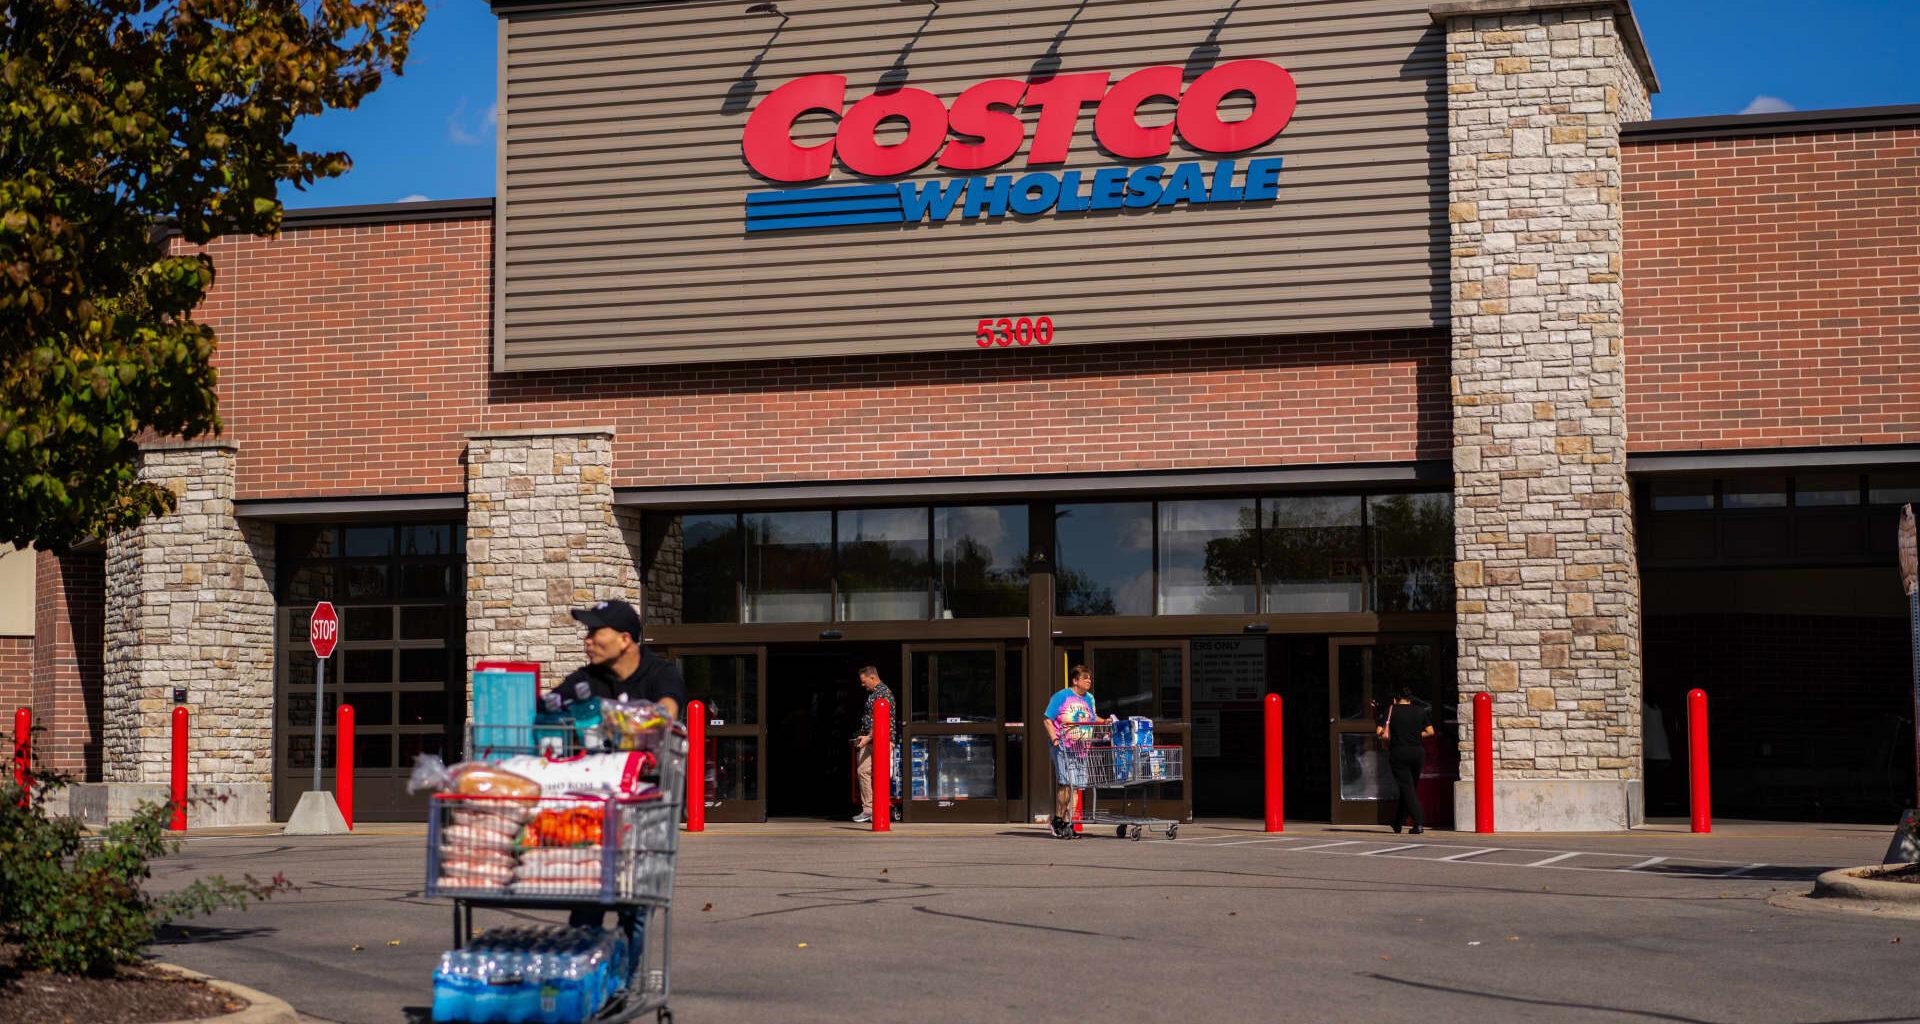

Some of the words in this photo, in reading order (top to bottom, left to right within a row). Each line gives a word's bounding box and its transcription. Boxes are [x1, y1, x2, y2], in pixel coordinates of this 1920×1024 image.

[742, 59, 1297, 182] COSTCO
[900, 158, 1283, 223] WHOLESALE
[976, 316, 1053, 347] 5300
[312, 619, 336, 640] STOP
[1214, 640, 1240, 650] ONLY
